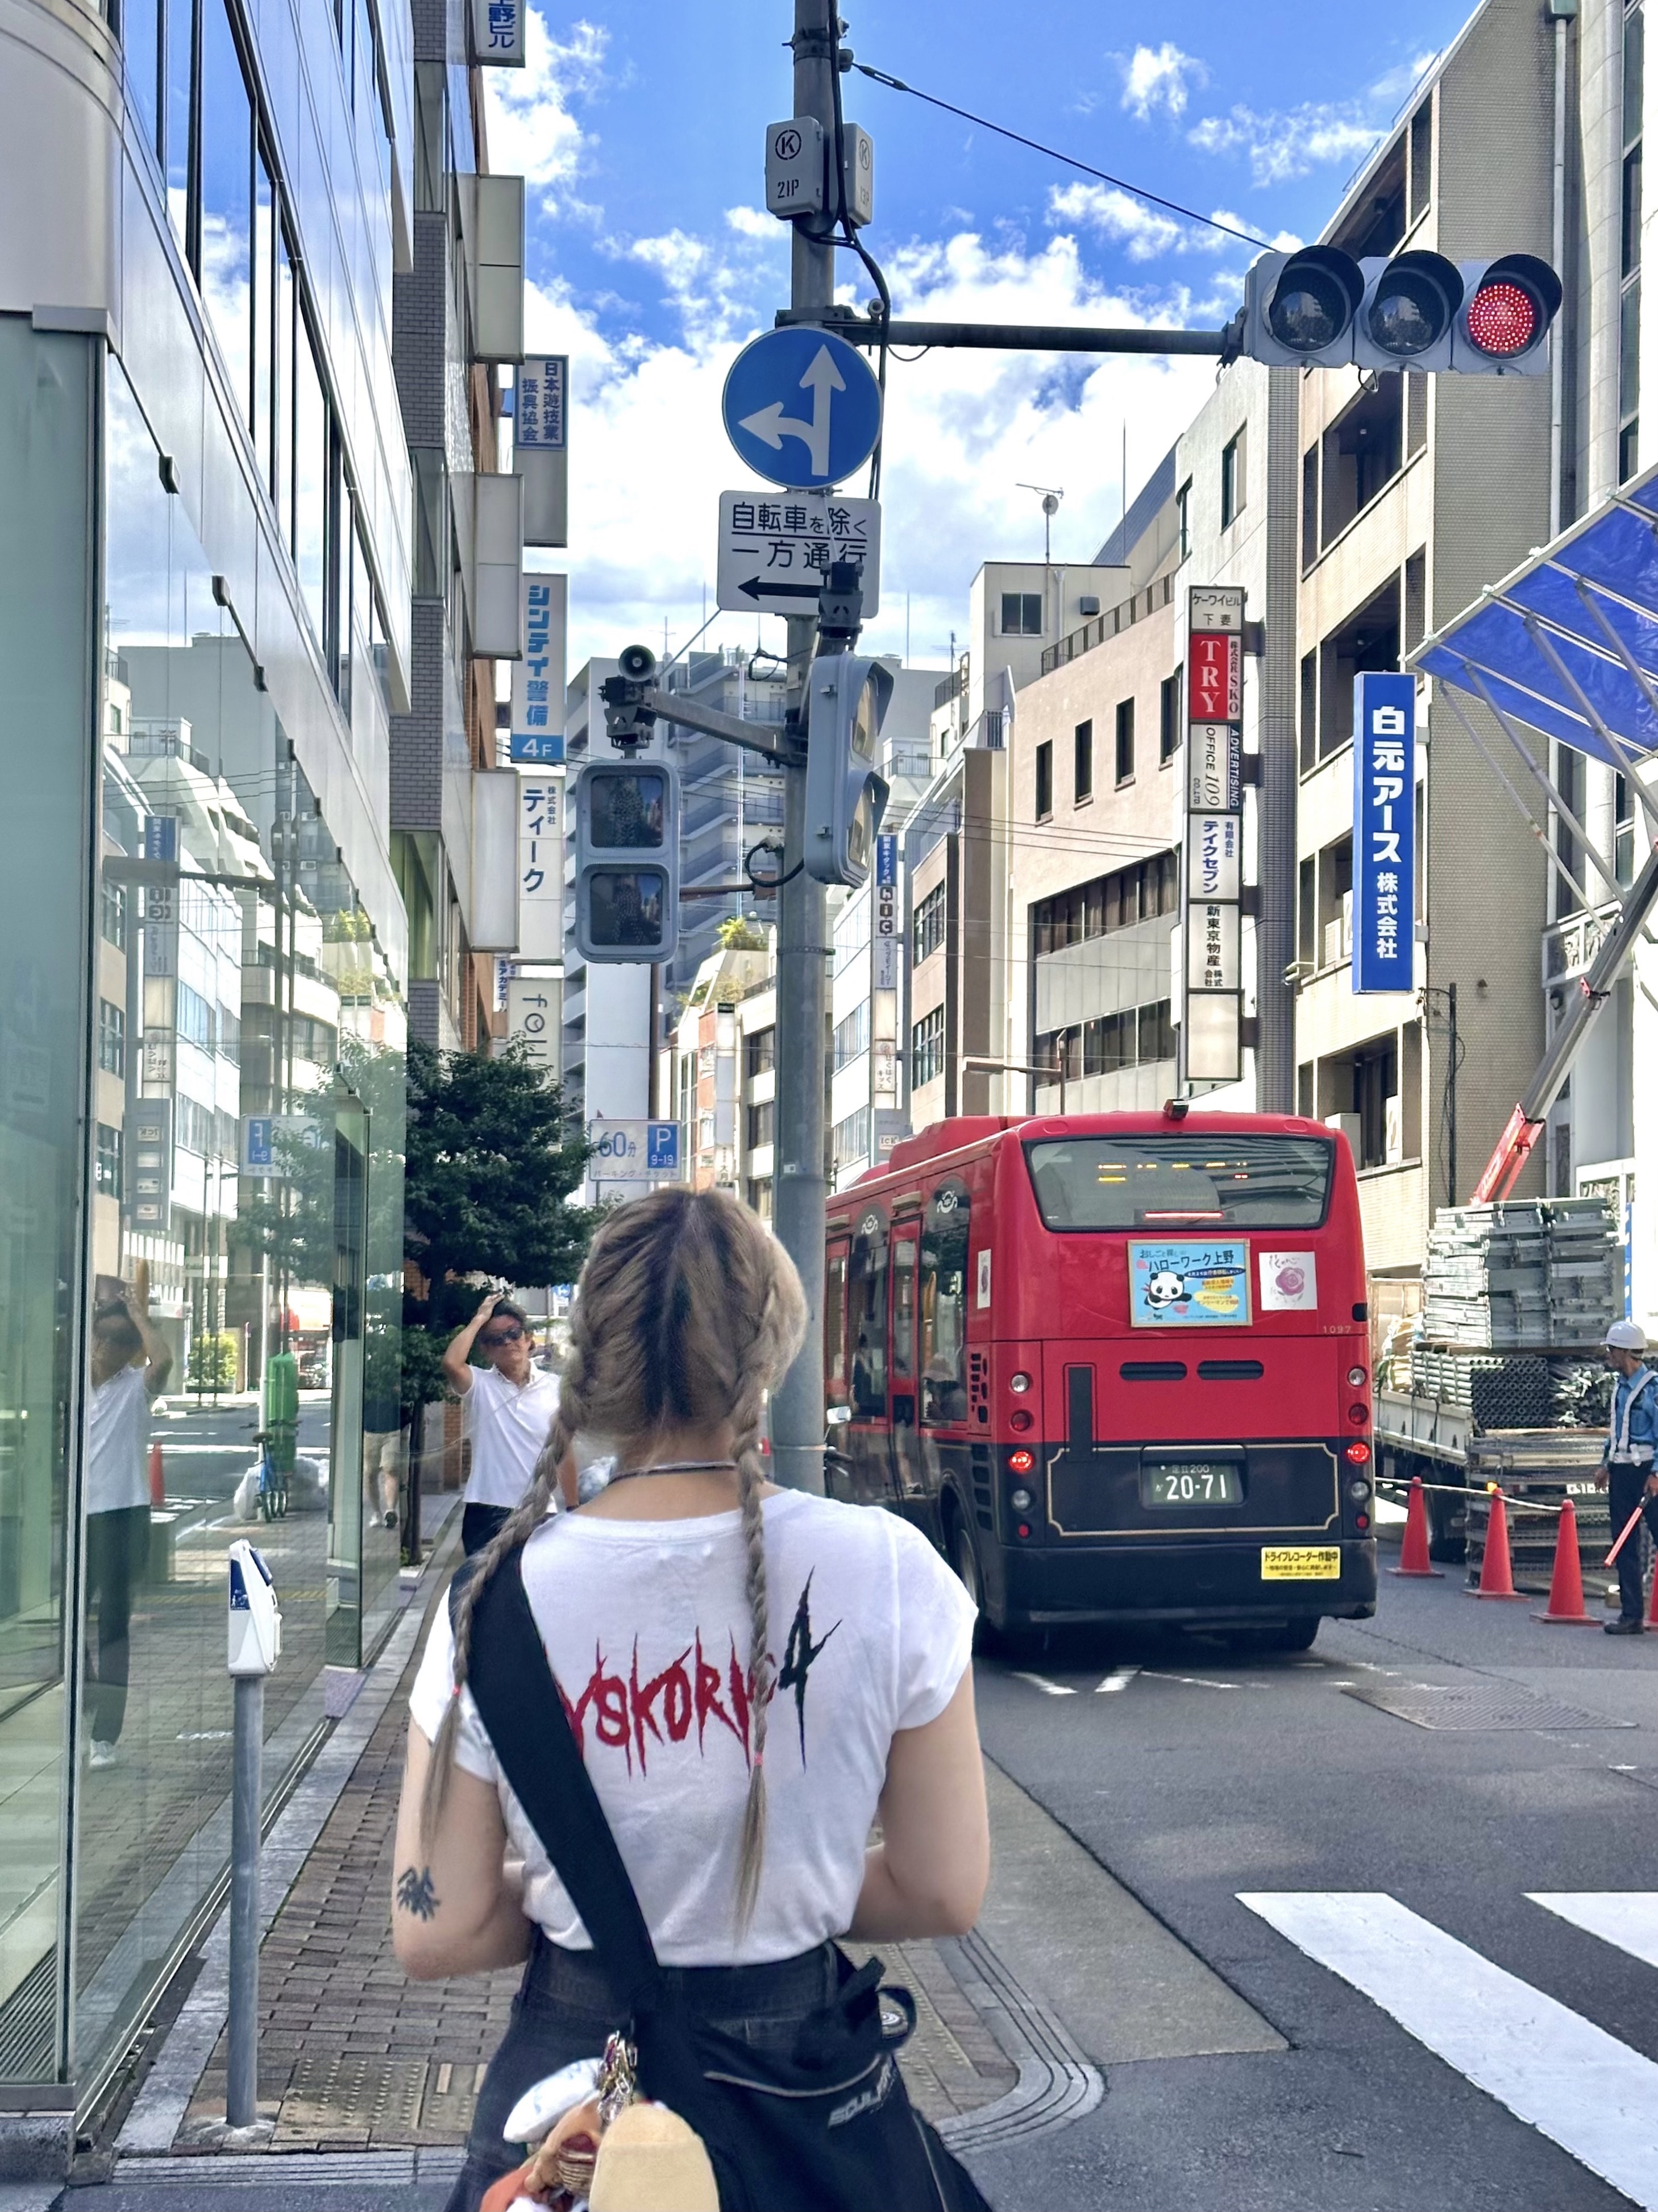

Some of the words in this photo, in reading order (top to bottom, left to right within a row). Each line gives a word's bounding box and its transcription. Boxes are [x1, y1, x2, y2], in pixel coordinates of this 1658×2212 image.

[733, 501, 867, 536] 自転車を除く
[732, 540, 867, 569] 一方通行
[1192, 594, 1241, 607] ケーワイビル
[1203, 613, 1232, 626] 下妻
[526, 584, 550, 727] シンテイ警備
[1200, 641, 1221, 712] TRY
[1206, 727, 1216, 770] OFFICE
[1230, 728, 1240, 806] ADVERTISING
[1204, 774, 1220, 806] 109
[1373, 706, 1405, 863] 白元アース
[547, 785, 557, 825] 株式会社
[522, 788, 546, 893] ティーク
[1203, 820, 1219, 894] テイクセブン
[1225, 821, 1235, 858] 有限会社
[1377, 871, 1398, 959] 株式会社
[1206, 905, 1221, 967] 新東京物産
[656, 1128, 672, 1152] P
[651, 1154, 674, 1166] 9-19
[1149, 1250, 1234, 1272] ハローワーク上野
[1165, 1474, 1226, 1500] 20-71
[1265, 1551, 1338, 1562] ドライブレコーダー作動中
